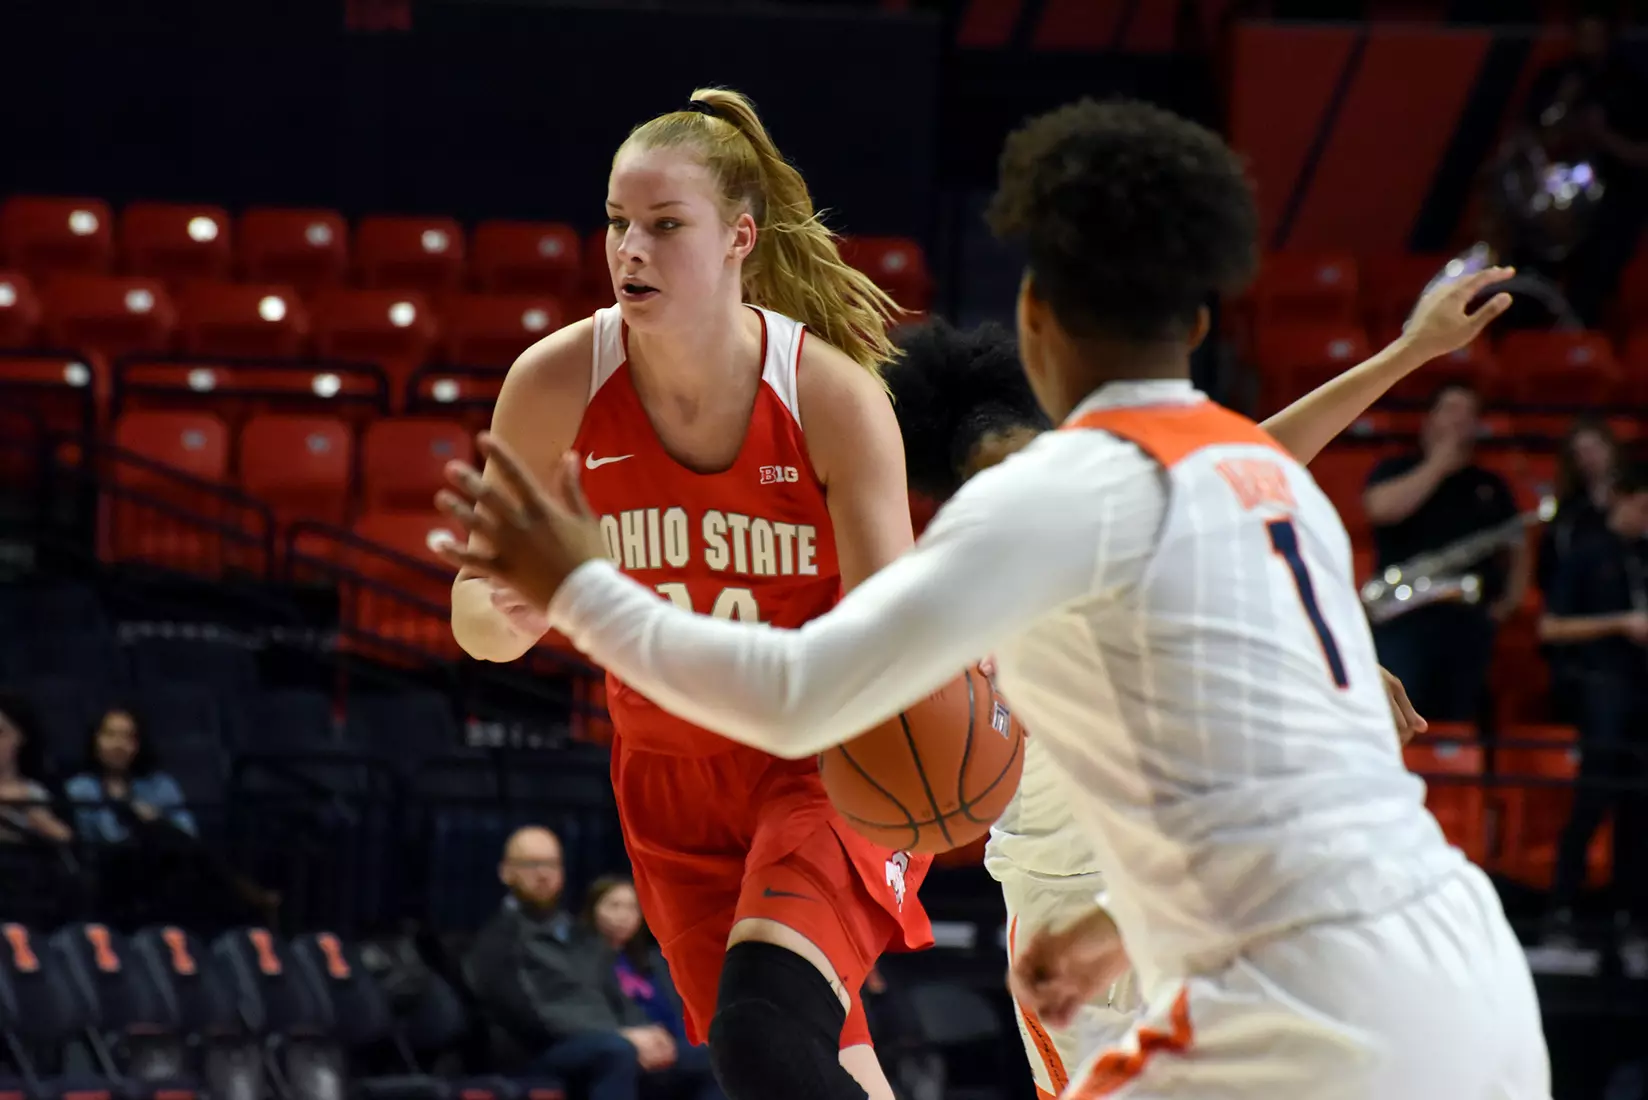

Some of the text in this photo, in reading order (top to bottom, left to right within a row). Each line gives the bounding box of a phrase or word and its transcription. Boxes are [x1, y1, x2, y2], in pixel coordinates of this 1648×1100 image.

[600, 506, 818, 575] OHIO STATE
[1265, 515, 1349, 689] 1
